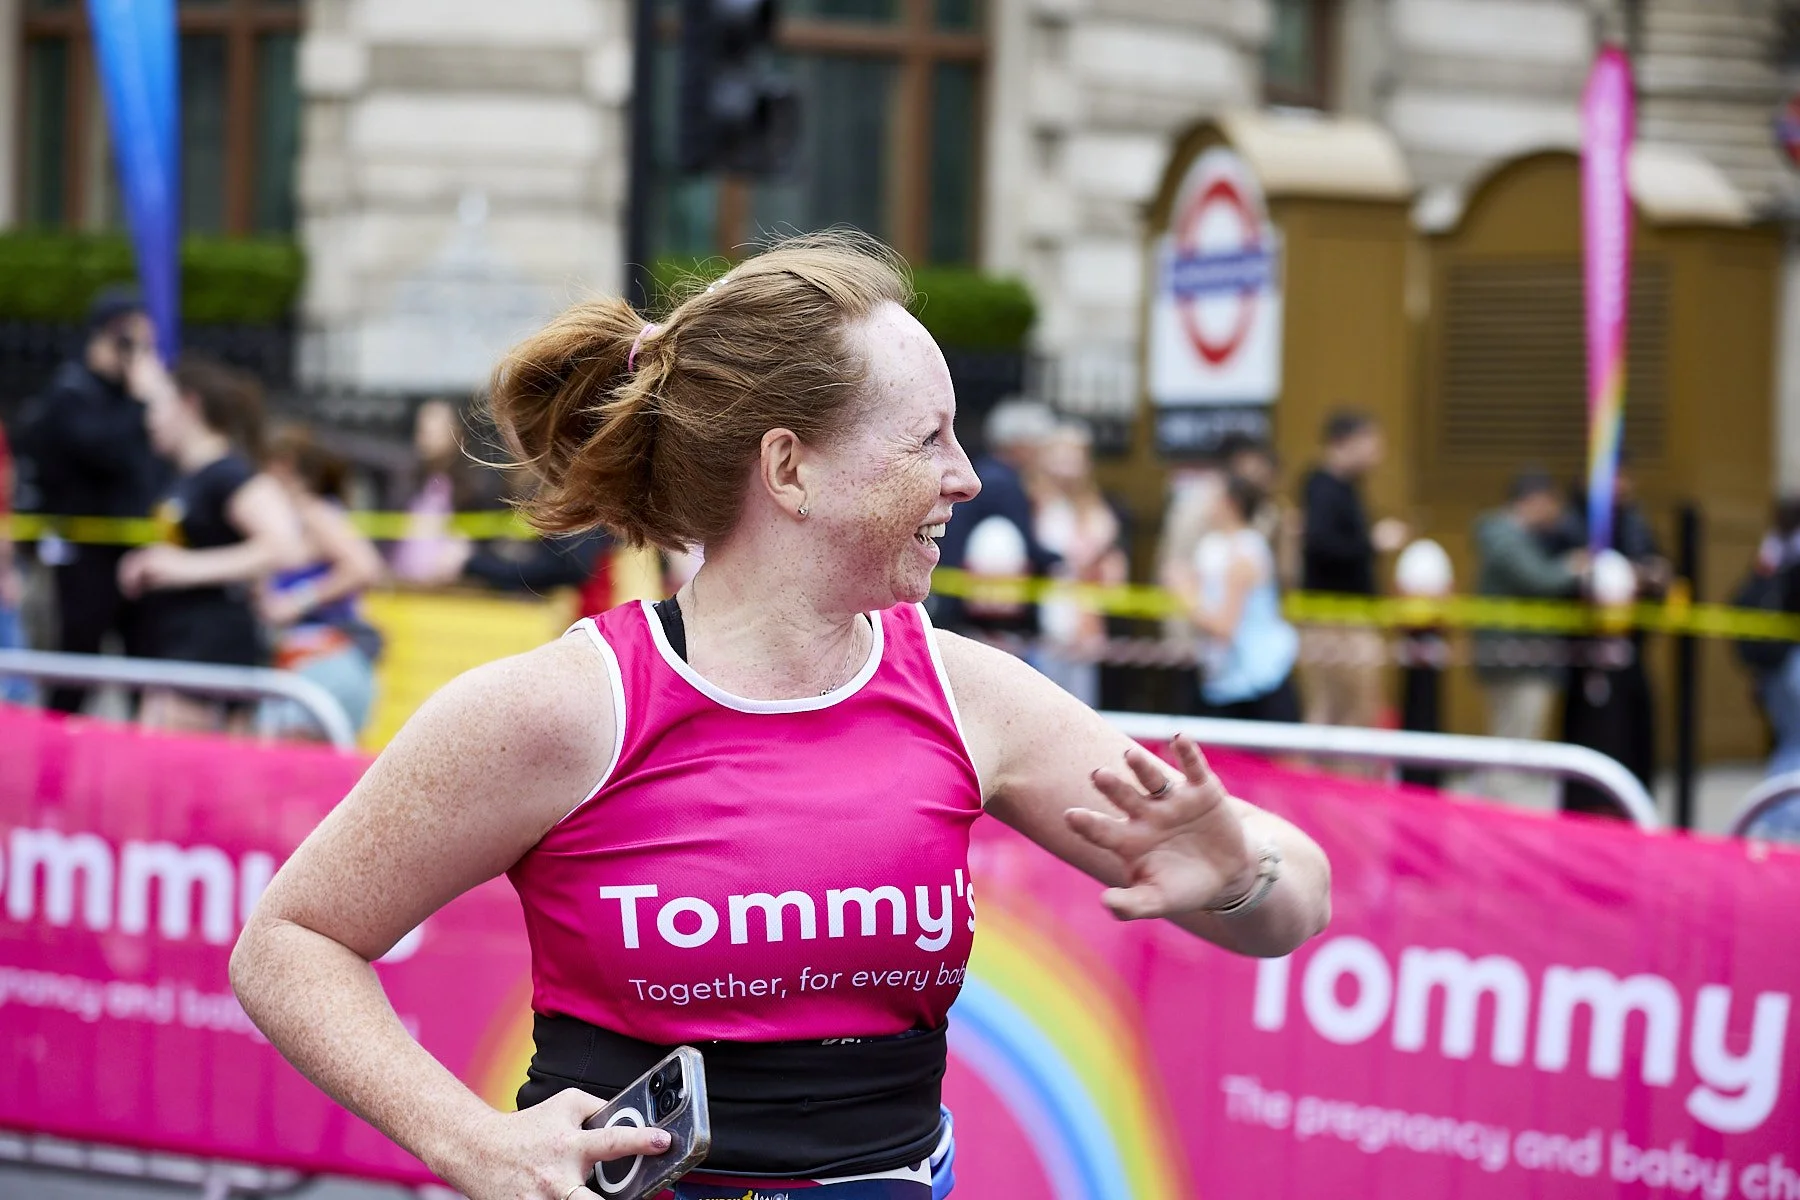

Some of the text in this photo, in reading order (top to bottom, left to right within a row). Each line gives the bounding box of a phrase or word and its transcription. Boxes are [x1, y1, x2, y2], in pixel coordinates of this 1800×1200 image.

[600, 868, 976, 952] Tommy's
[628, 972, 787, 1006] Together,
[799, 966, 843, 993] for
[851, 967, 930, 992] every
[1295, 1095, 1510, 1173] pregnancy
[1513, 1128, 1603, 1178] and
[1610, 1128, 1733, 1200] baby
[1739, 1152, 1800, 1200] ch
